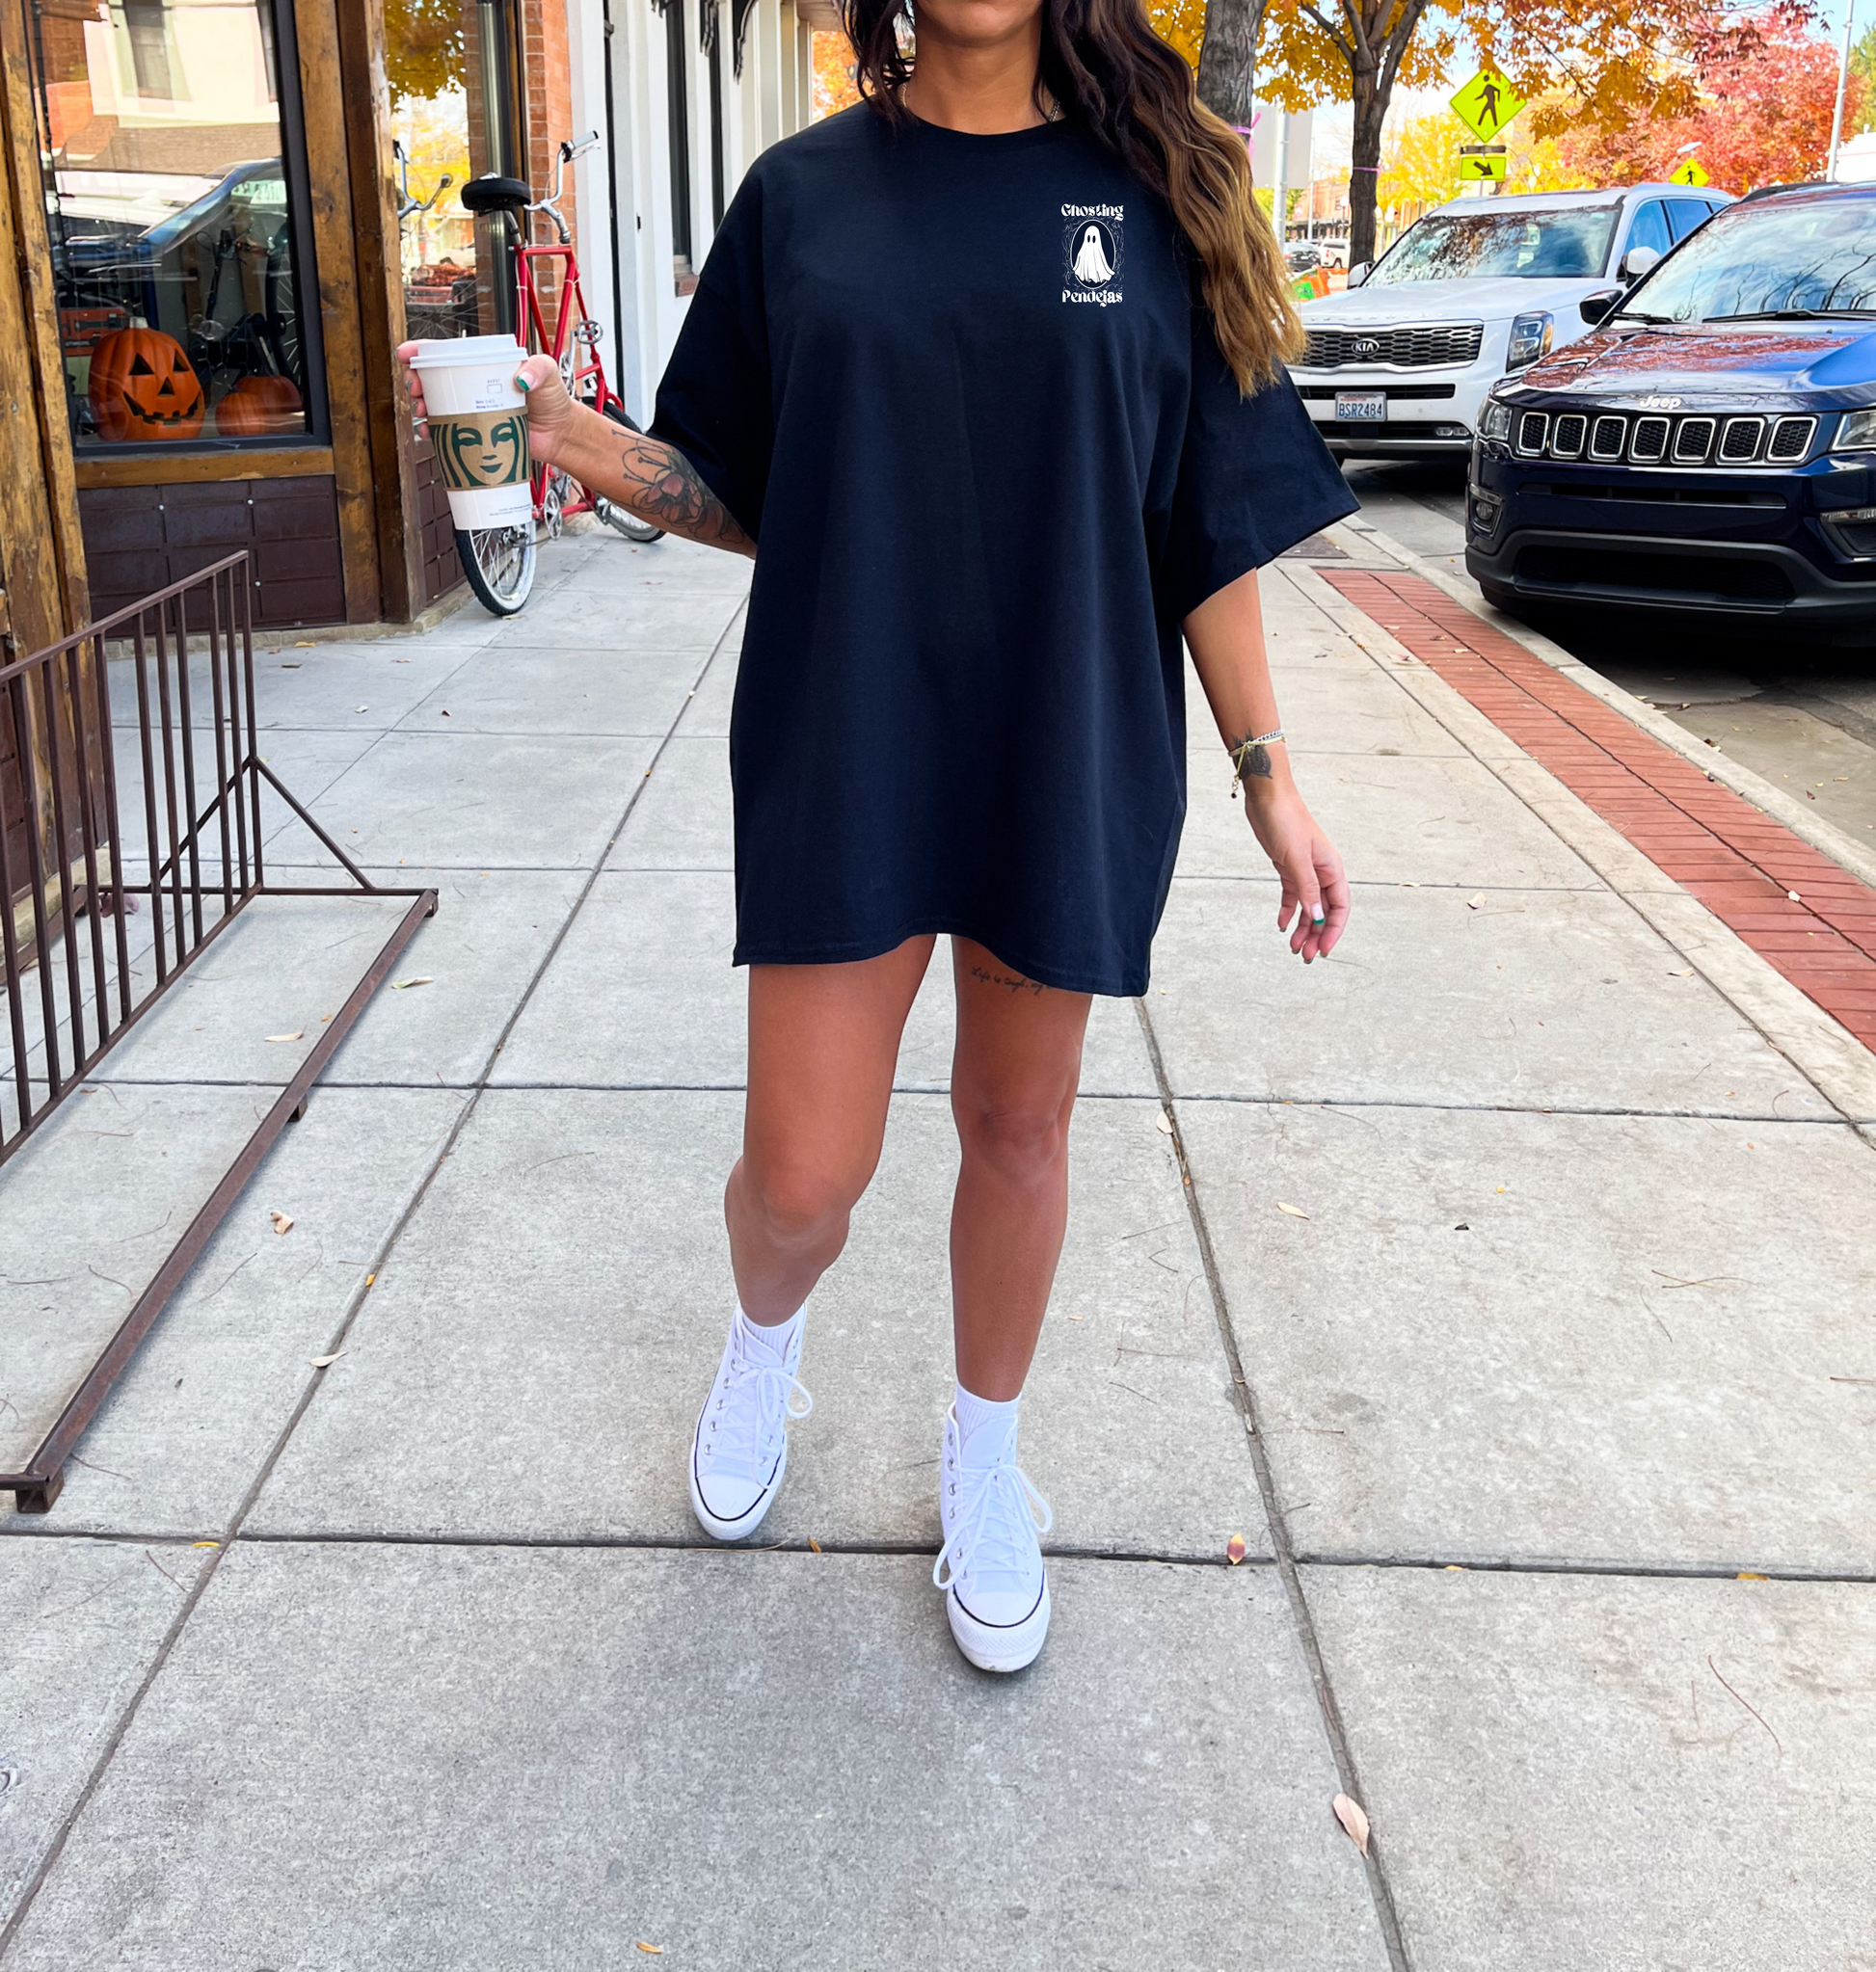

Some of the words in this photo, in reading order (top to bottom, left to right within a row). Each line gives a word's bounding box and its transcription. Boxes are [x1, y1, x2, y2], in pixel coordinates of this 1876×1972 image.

[1060, 203, 1124, 222] Ghosting
[1061, 289, 1123, 307] Pendejas
[1354, 342, 1375, 352] KIA
[1338, 402, 1382, 417] BSR2484
[1639, 395, 1682, 411] Jeep
